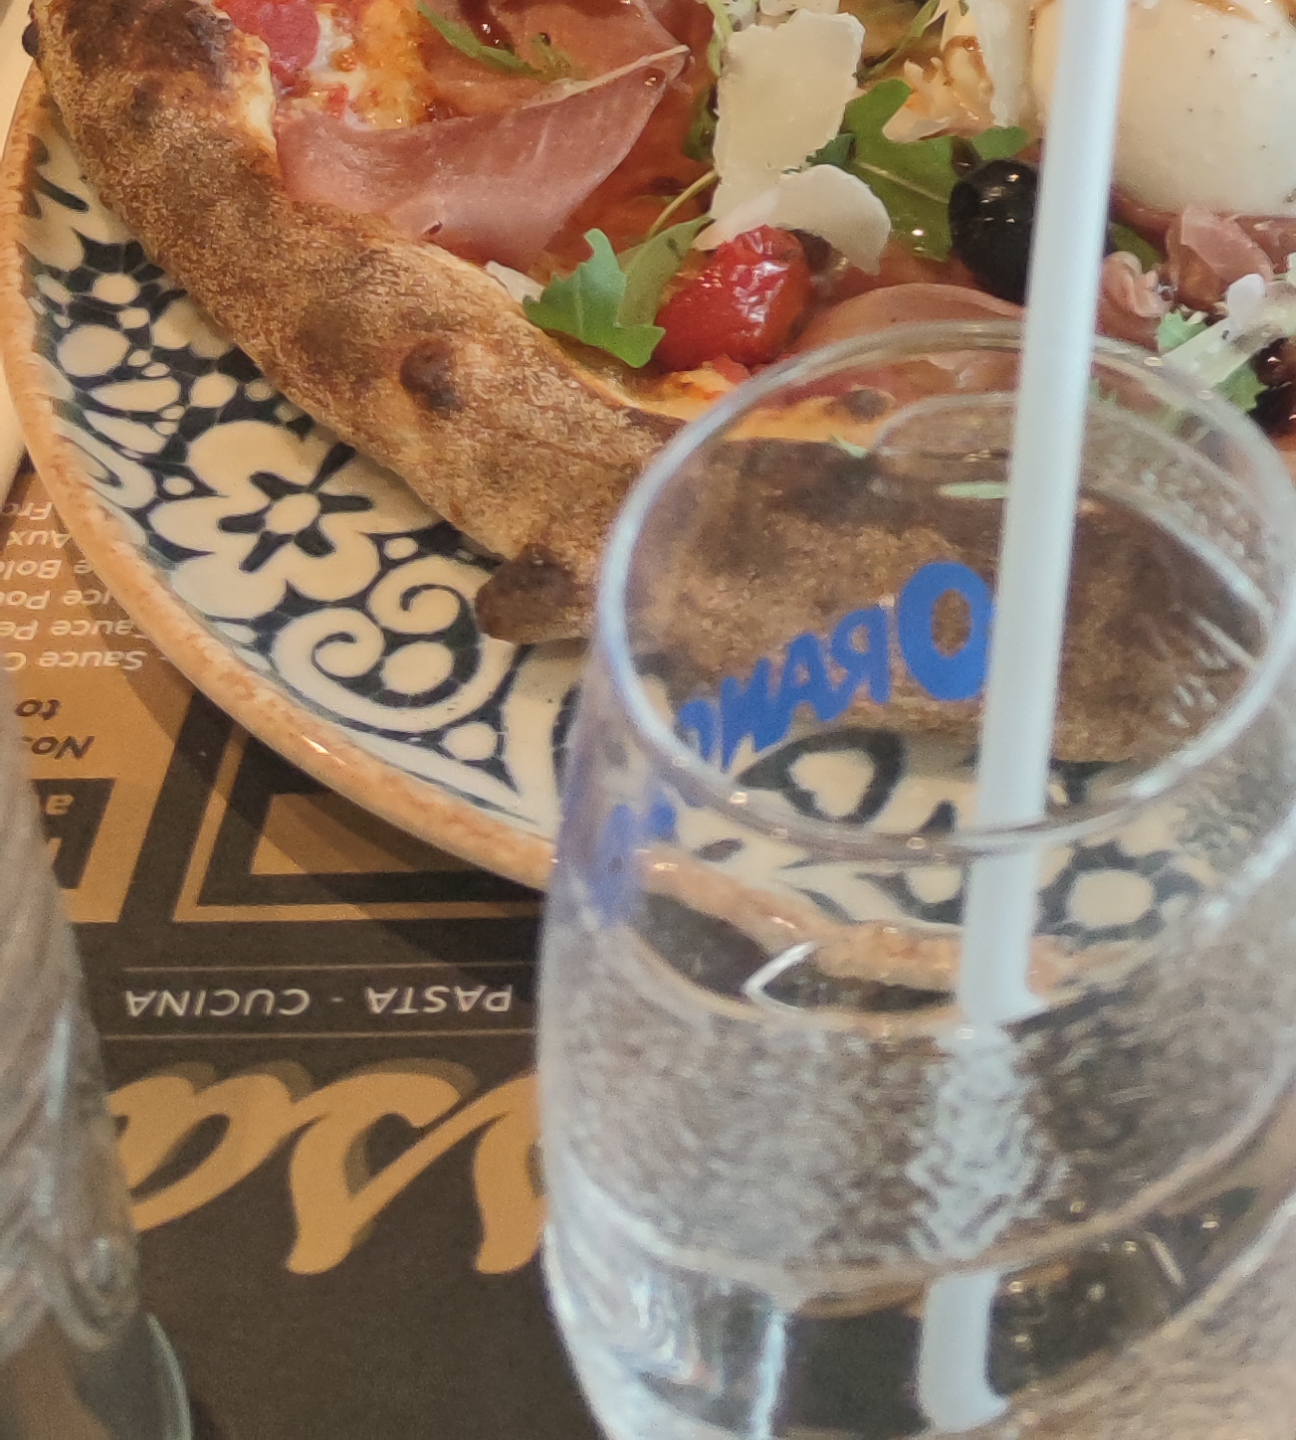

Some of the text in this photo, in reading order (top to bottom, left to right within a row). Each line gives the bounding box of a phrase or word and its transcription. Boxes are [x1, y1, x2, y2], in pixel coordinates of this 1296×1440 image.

[38, 650, 148, 670] Sauce
[125, 987, 310, 1018] CUCINA
[365, 984, 514, 1015] PASTA
